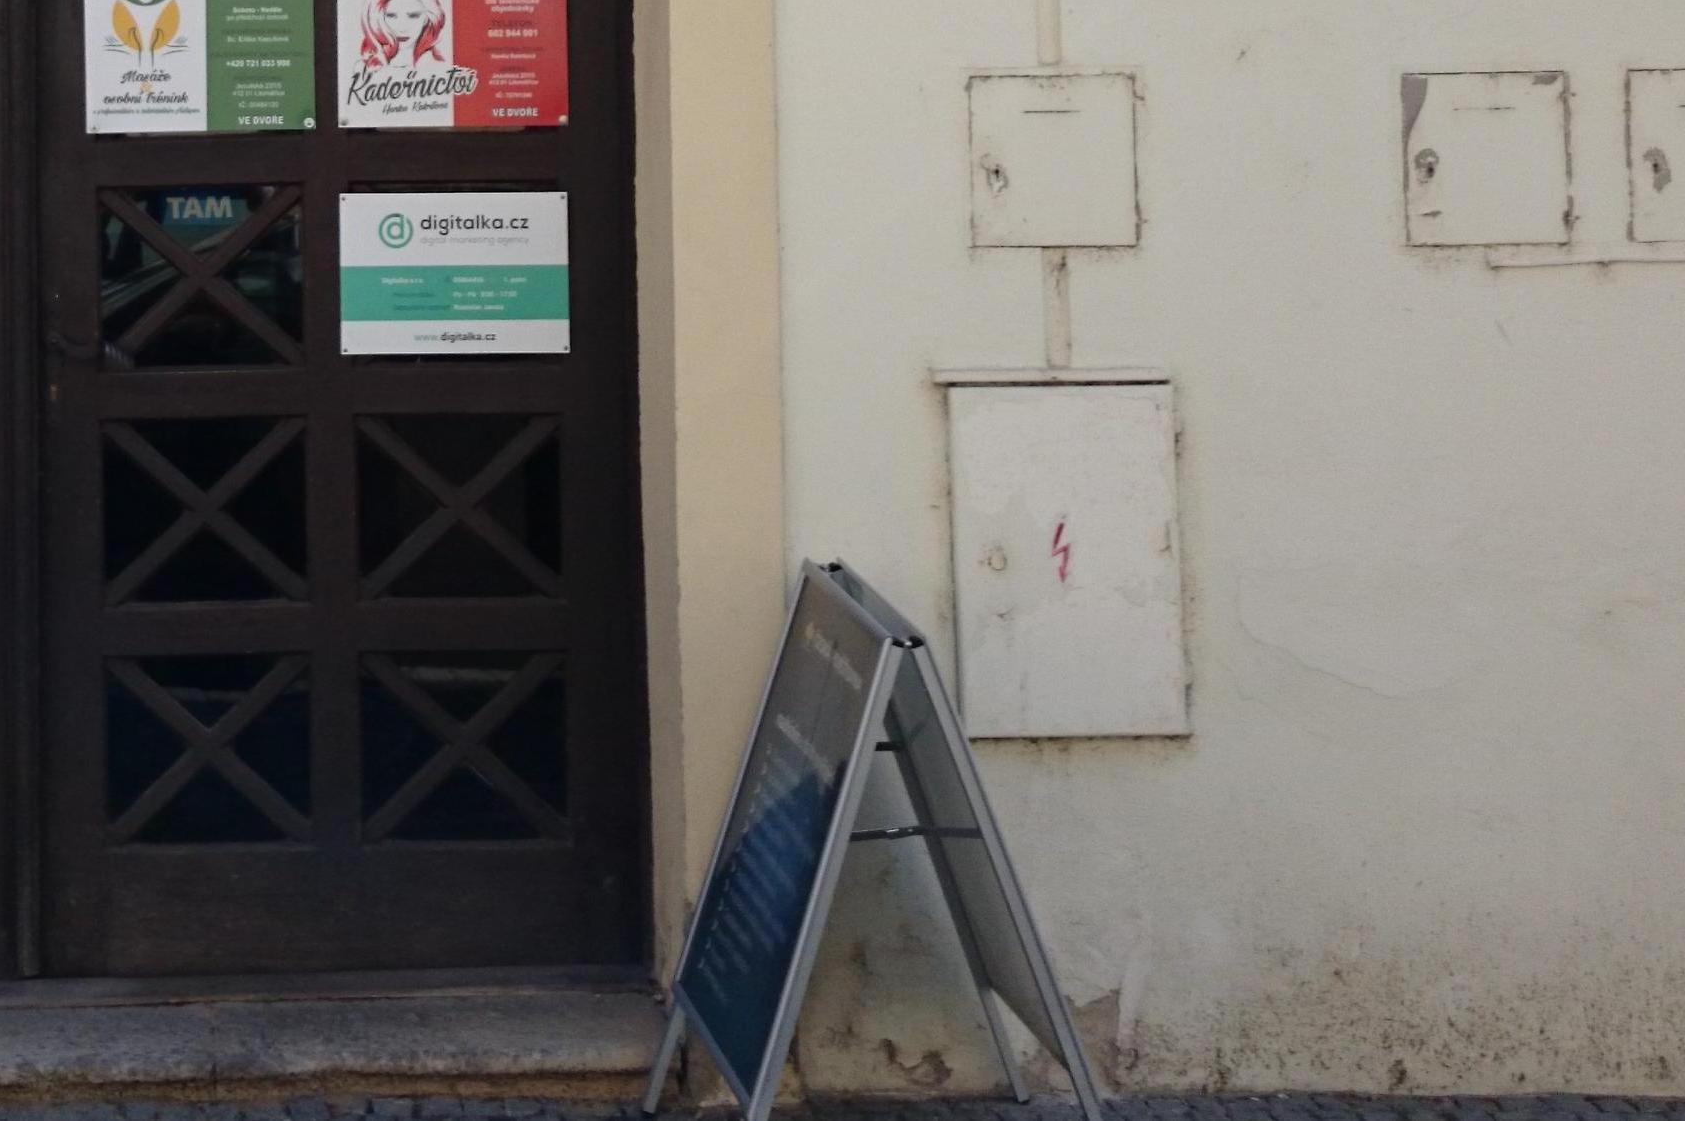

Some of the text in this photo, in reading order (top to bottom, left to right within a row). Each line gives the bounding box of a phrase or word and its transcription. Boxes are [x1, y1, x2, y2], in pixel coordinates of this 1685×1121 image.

[120, 69, 172, 84] Masáže
[103, 91, 142, 105] osobní
[492, 107, 539, 117] VE DVOŘE
[238, 115, 285, 126] VE DVOŘE
[420, 214, 530, 235] digitalka.cz
[413, 331, 497, 343] www.digitalka.cz
